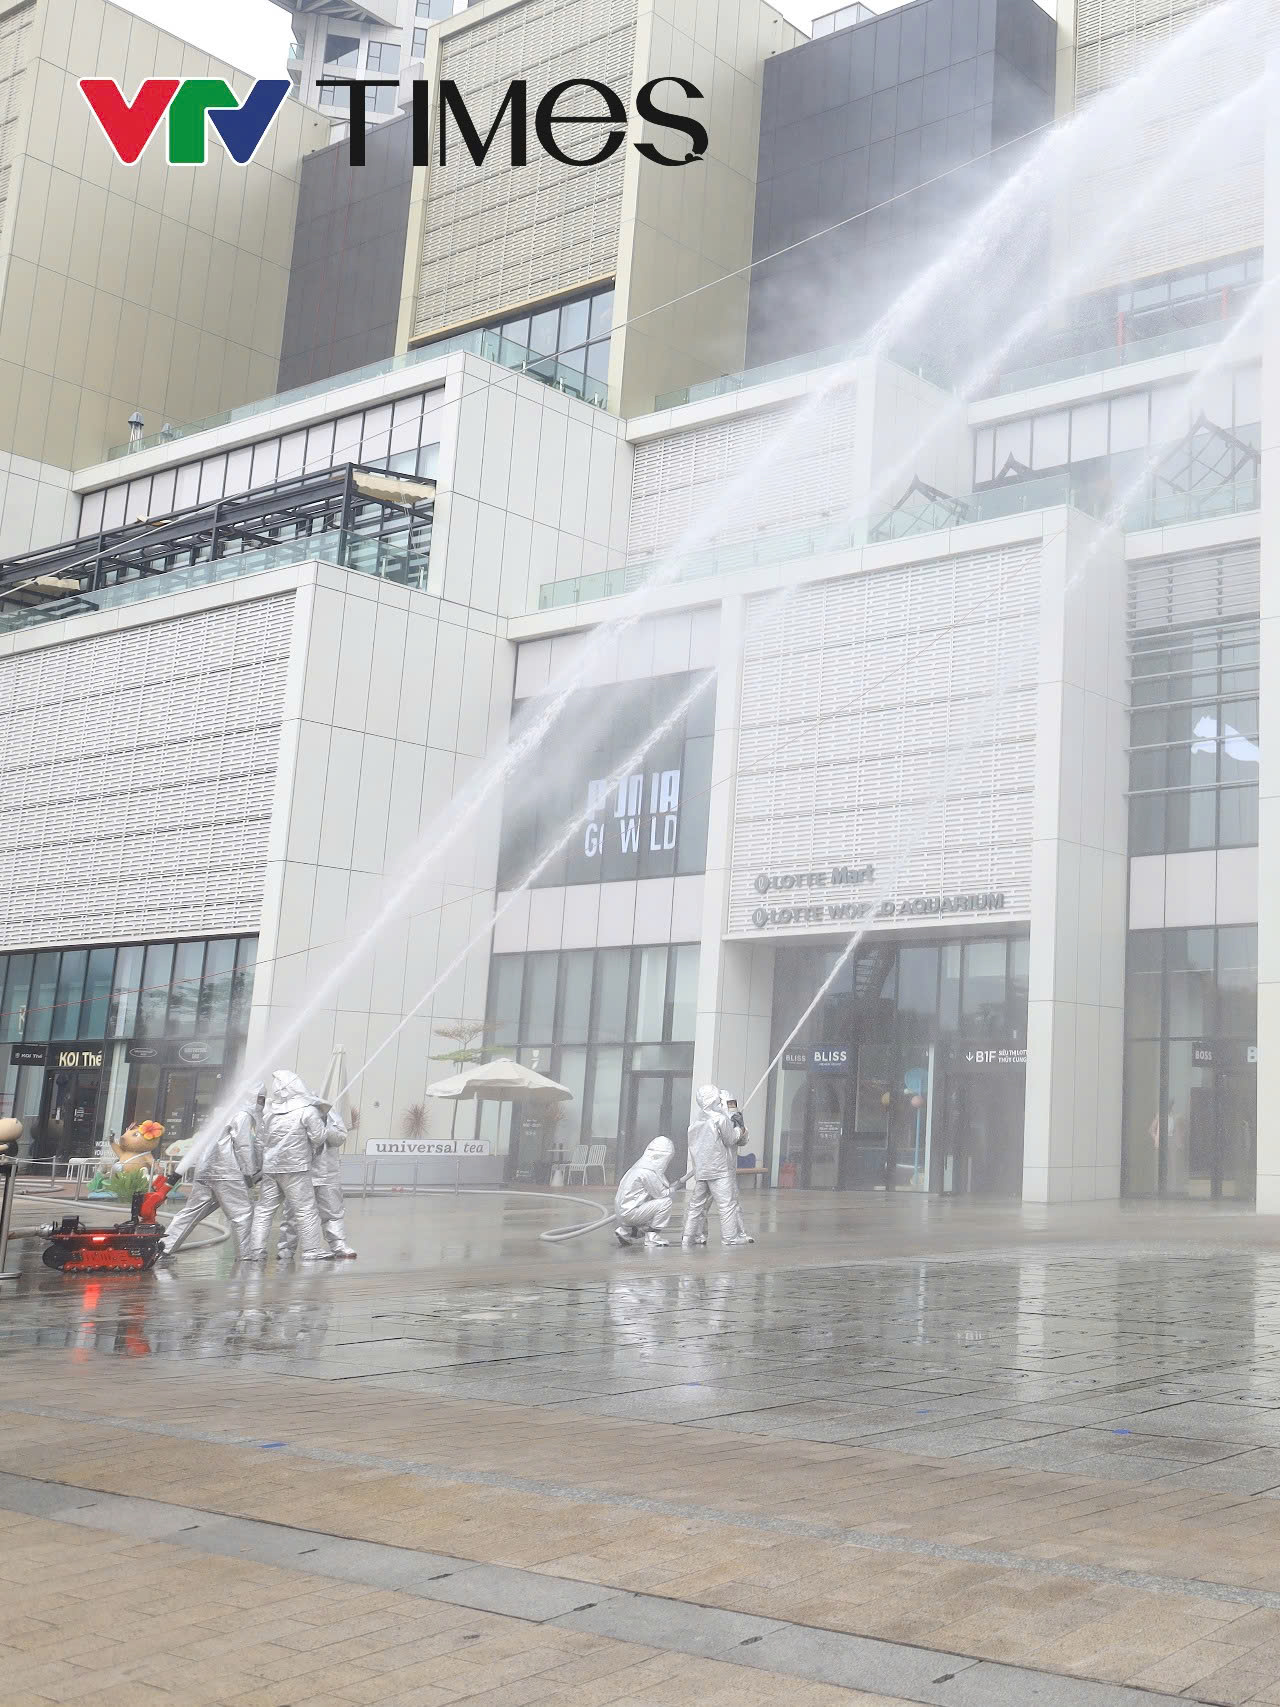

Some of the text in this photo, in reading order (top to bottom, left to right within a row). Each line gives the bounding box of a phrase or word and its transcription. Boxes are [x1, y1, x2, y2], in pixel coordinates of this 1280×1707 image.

[620, 815, 677, 854] WLD
[769, 864, 874, 890] LOTTE Mart
[768, 893, 1005, 924] LOTTE WORD AQUARIUM
[58, 1050, 103, 1067] KOI Thé
[785, 1054, 806, 1062] BLISS
[814, 1051, 847, 1062] BLISS
[976, 1050, 997, 1063] B1F
[1195, 1050, 1213, 1061] BOSS
[375, 1140, 484, 1154] universal tea
